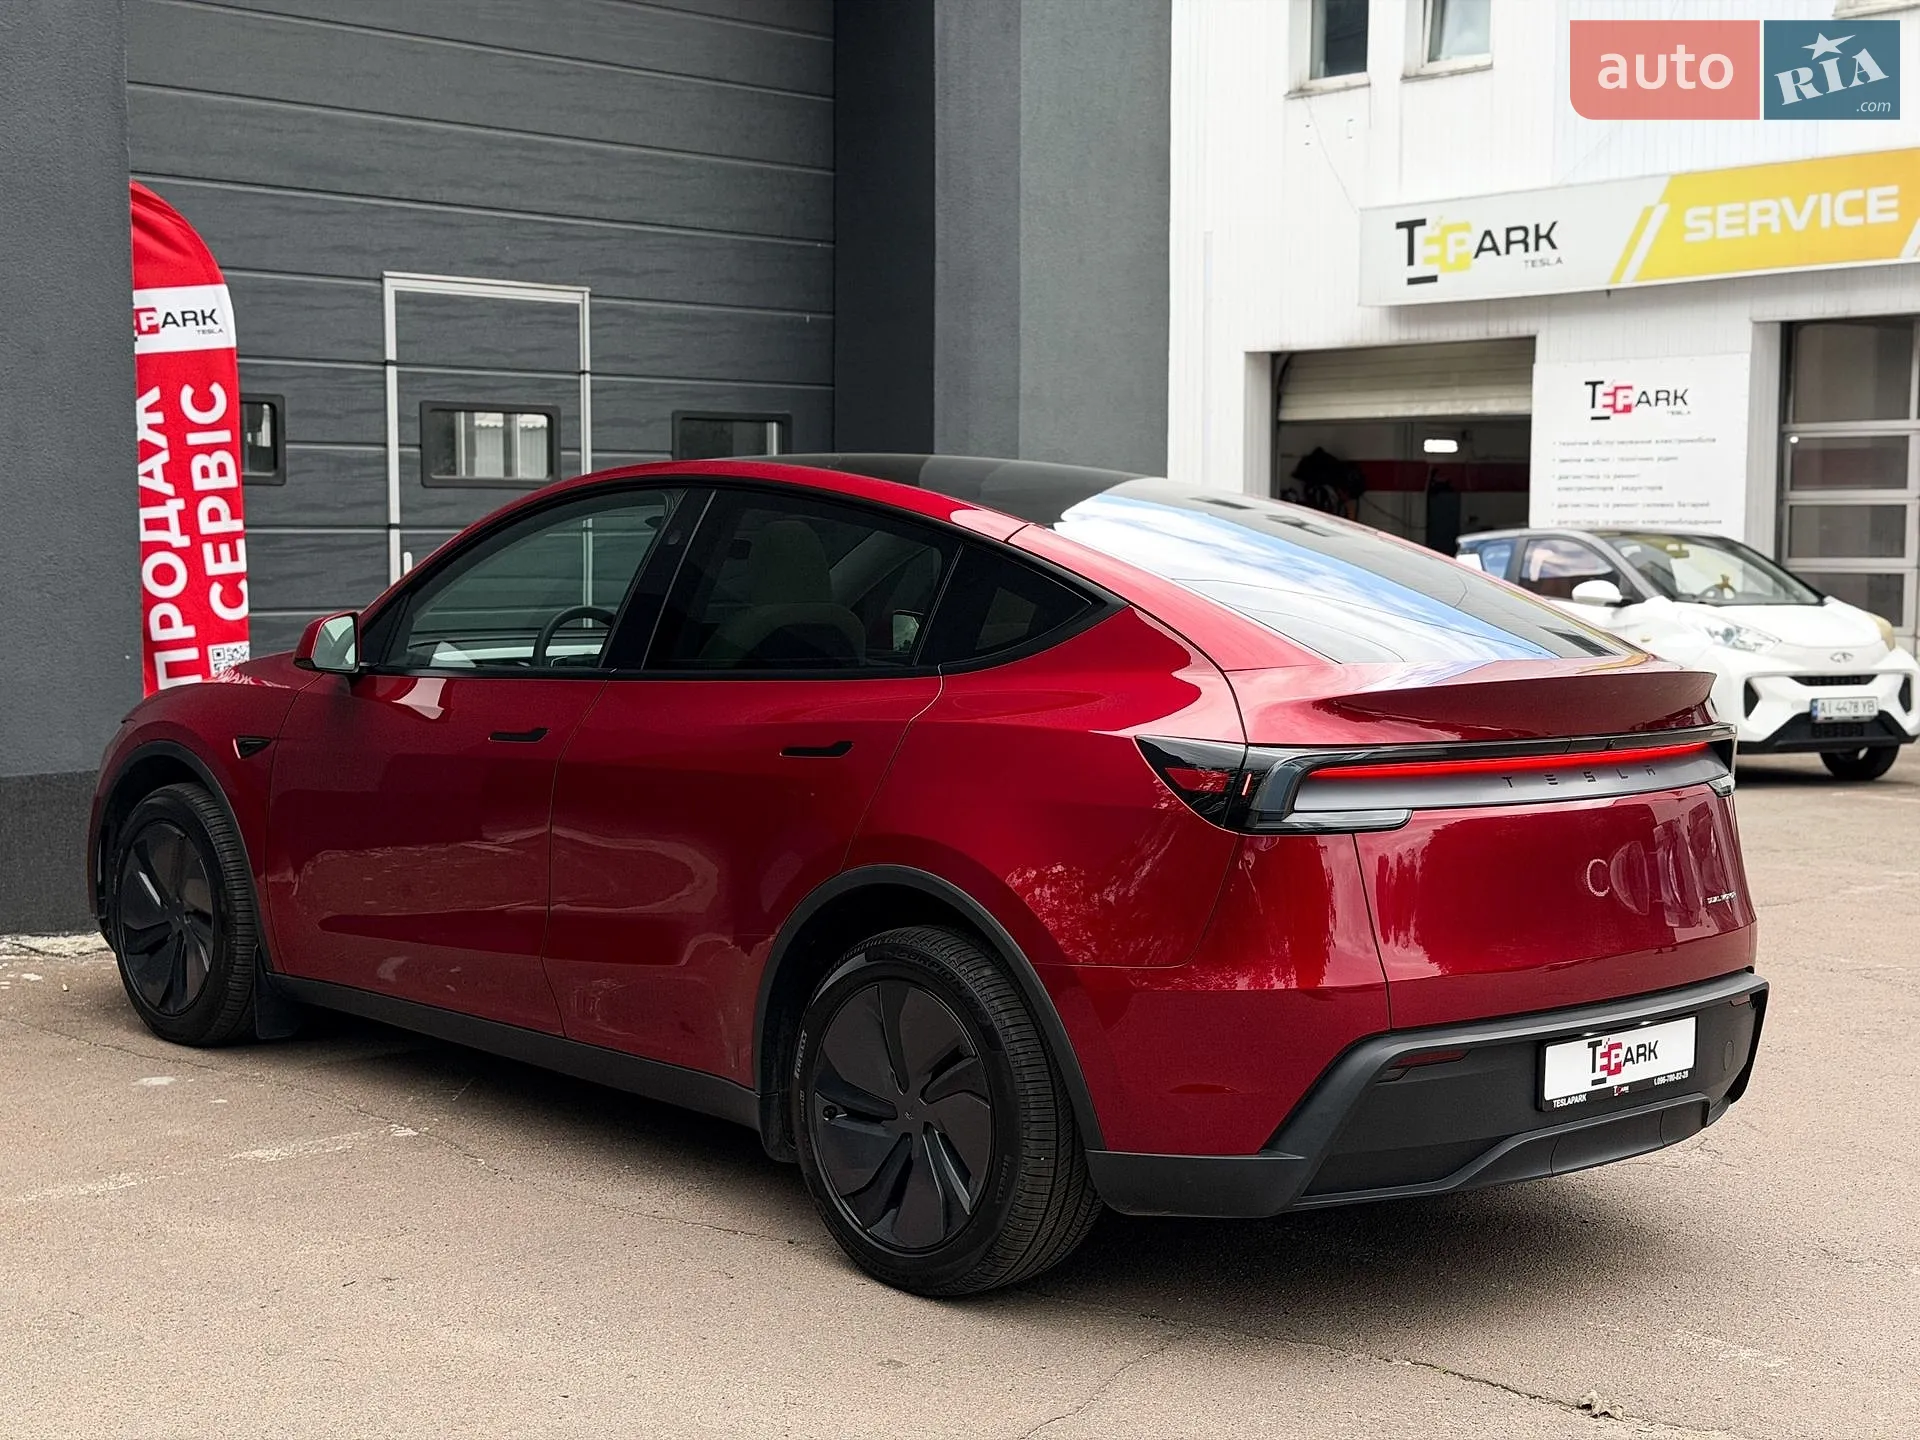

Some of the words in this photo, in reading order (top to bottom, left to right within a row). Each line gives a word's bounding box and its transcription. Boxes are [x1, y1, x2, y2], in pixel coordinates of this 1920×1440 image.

[1683, 185, 1899, 243] SERVICE
[1523, 257, 1563, 269] TESLA
[179, 381, 249, 621] СЕРВІС
[136, 386, 202, 690] ПРОДАЖ
[1501, 765, 1657, 789] TESLA
[1552, 1093, 1587, 1109] TESLAPARK
